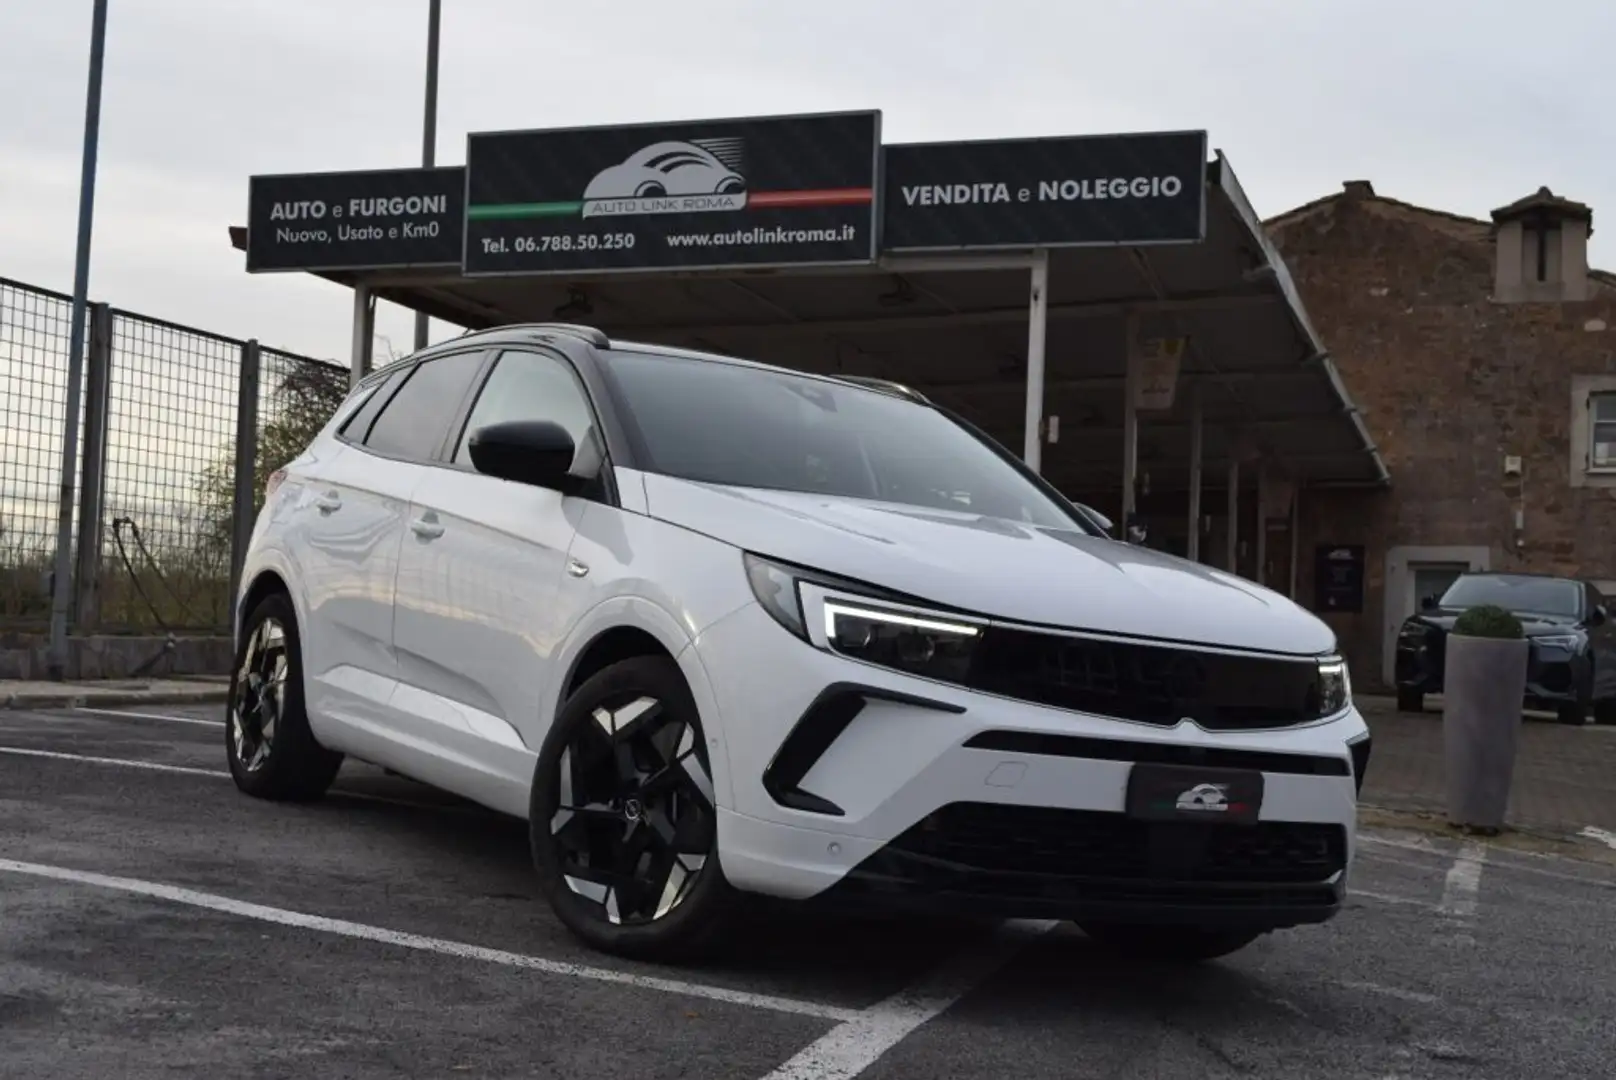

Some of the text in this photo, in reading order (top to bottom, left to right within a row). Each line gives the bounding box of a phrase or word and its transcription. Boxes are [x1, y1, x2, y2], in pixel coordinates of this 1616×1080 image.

[901, 176, 1182, 205] VENDITA e NOLEGGIO
[270, 194, 447, 221] AUTO e FURGONI
[592, 197, 735, 214] AUTO LINK ROMA
[276, 221, 440, 244] Nuovo, Usato e Km0
[482, 232, 636, 253] Tel. 06.788.50.250
[667, 224, 856, 247] www.autolinkroma.it
